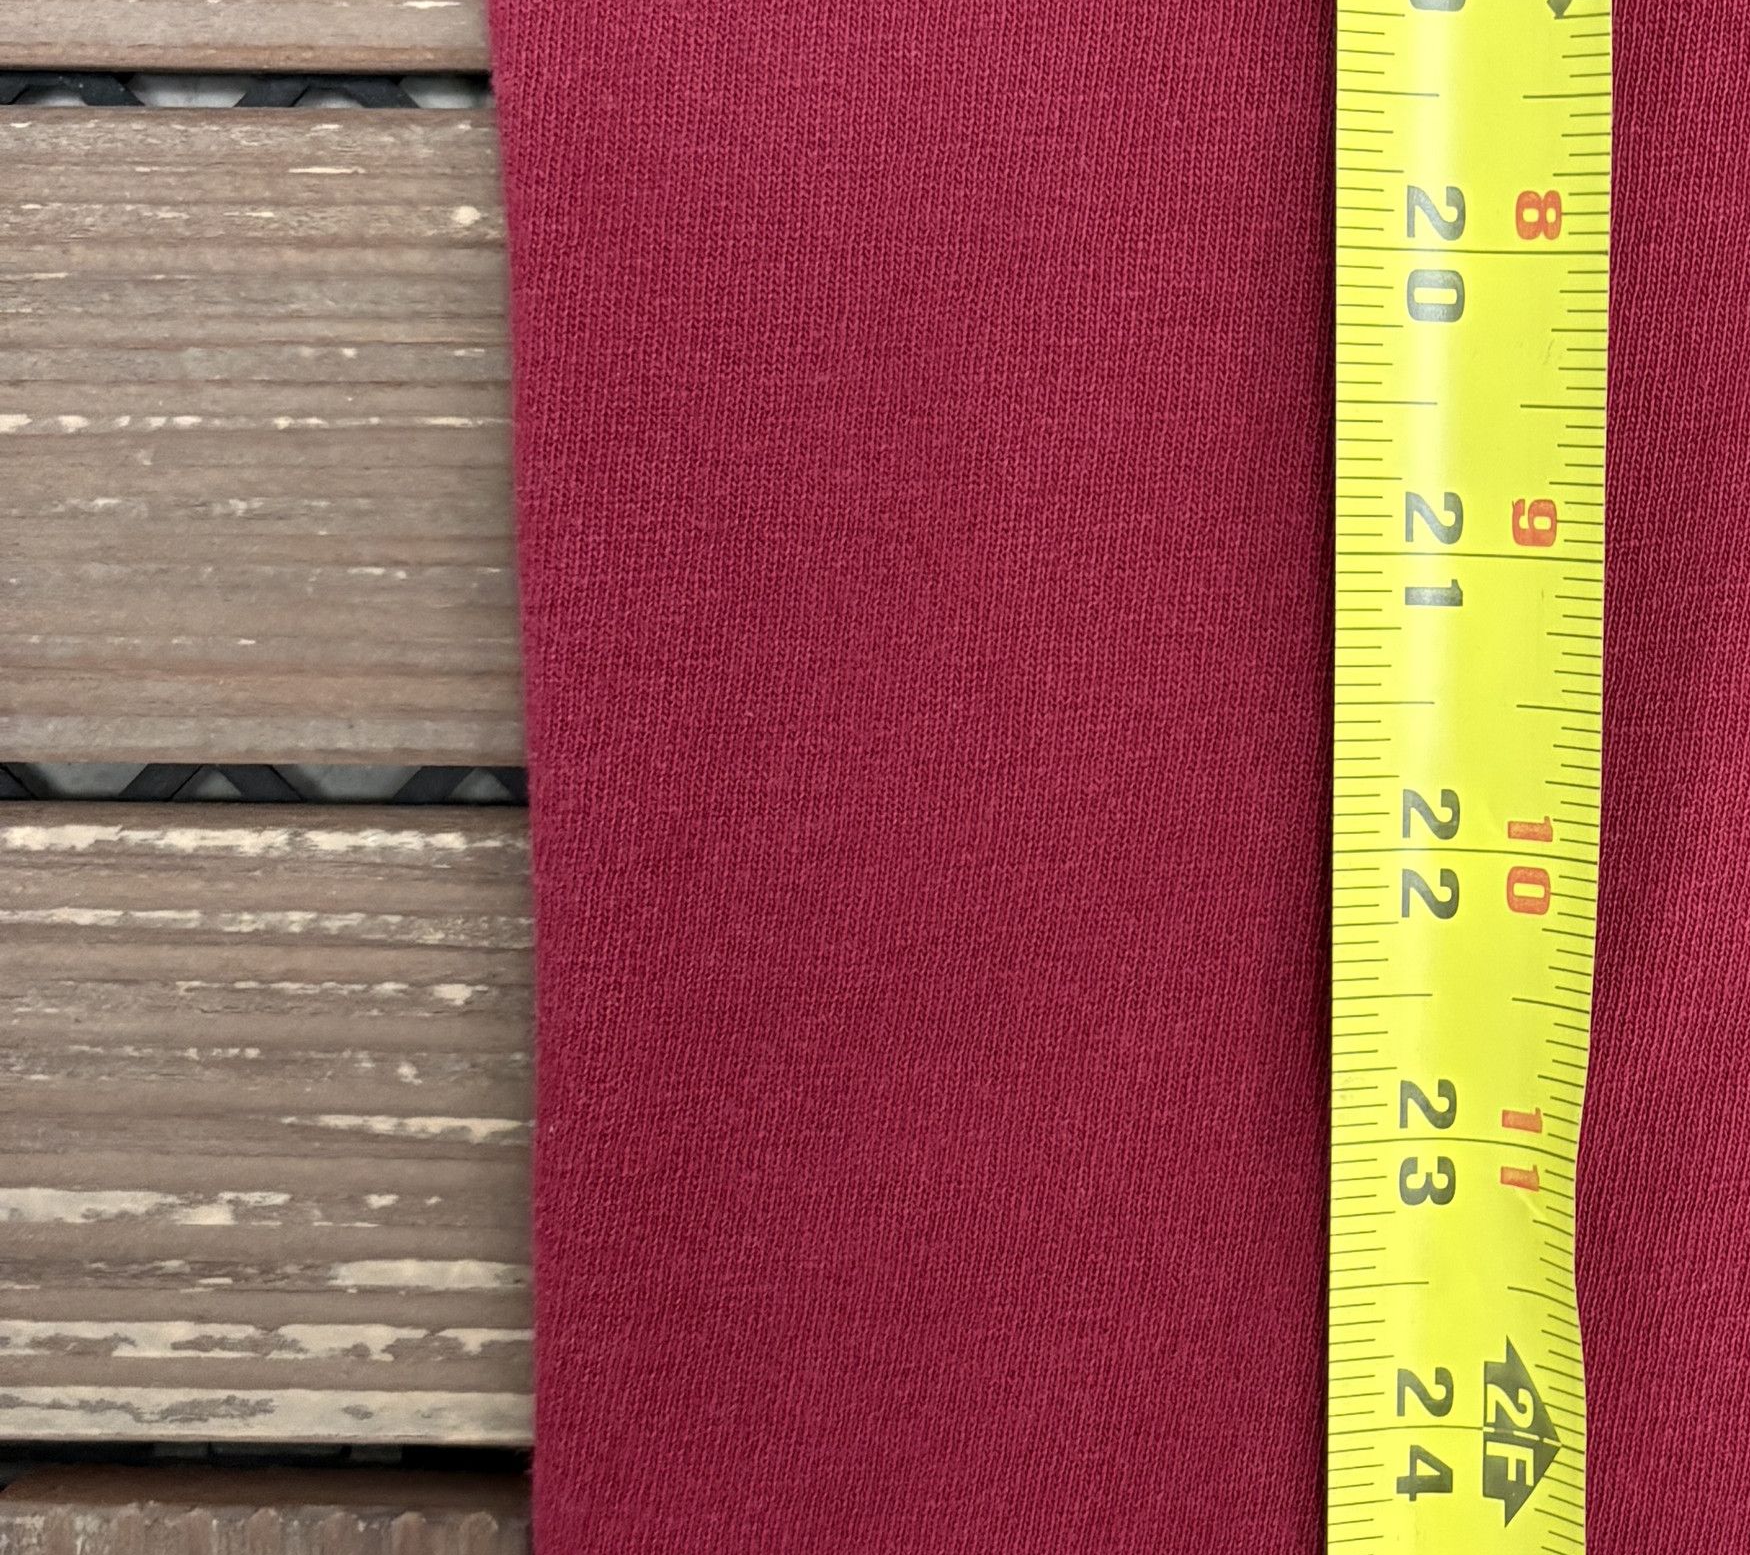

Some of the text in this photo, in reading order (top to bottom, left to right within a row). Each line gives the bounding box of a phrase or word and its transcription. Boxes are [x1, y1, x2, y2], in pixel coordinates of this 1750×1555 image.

[1406, 185, 1465, 323] 20
[1515, 190, 1562, 240] 8
[1404, 491, 1463, 607] 21
[1511, 498, 1557, 547] 9
[1401, 788, 1460, 919] 22
[1506, 816, 1553, 915] 10
[1399, 1079, 1457, 1206] 23
[1500, 1107, 1543, 1191] 11
[1396, 1367, 1454, 1502] 24
[1484, 1381, 1535, 1489] 2F
